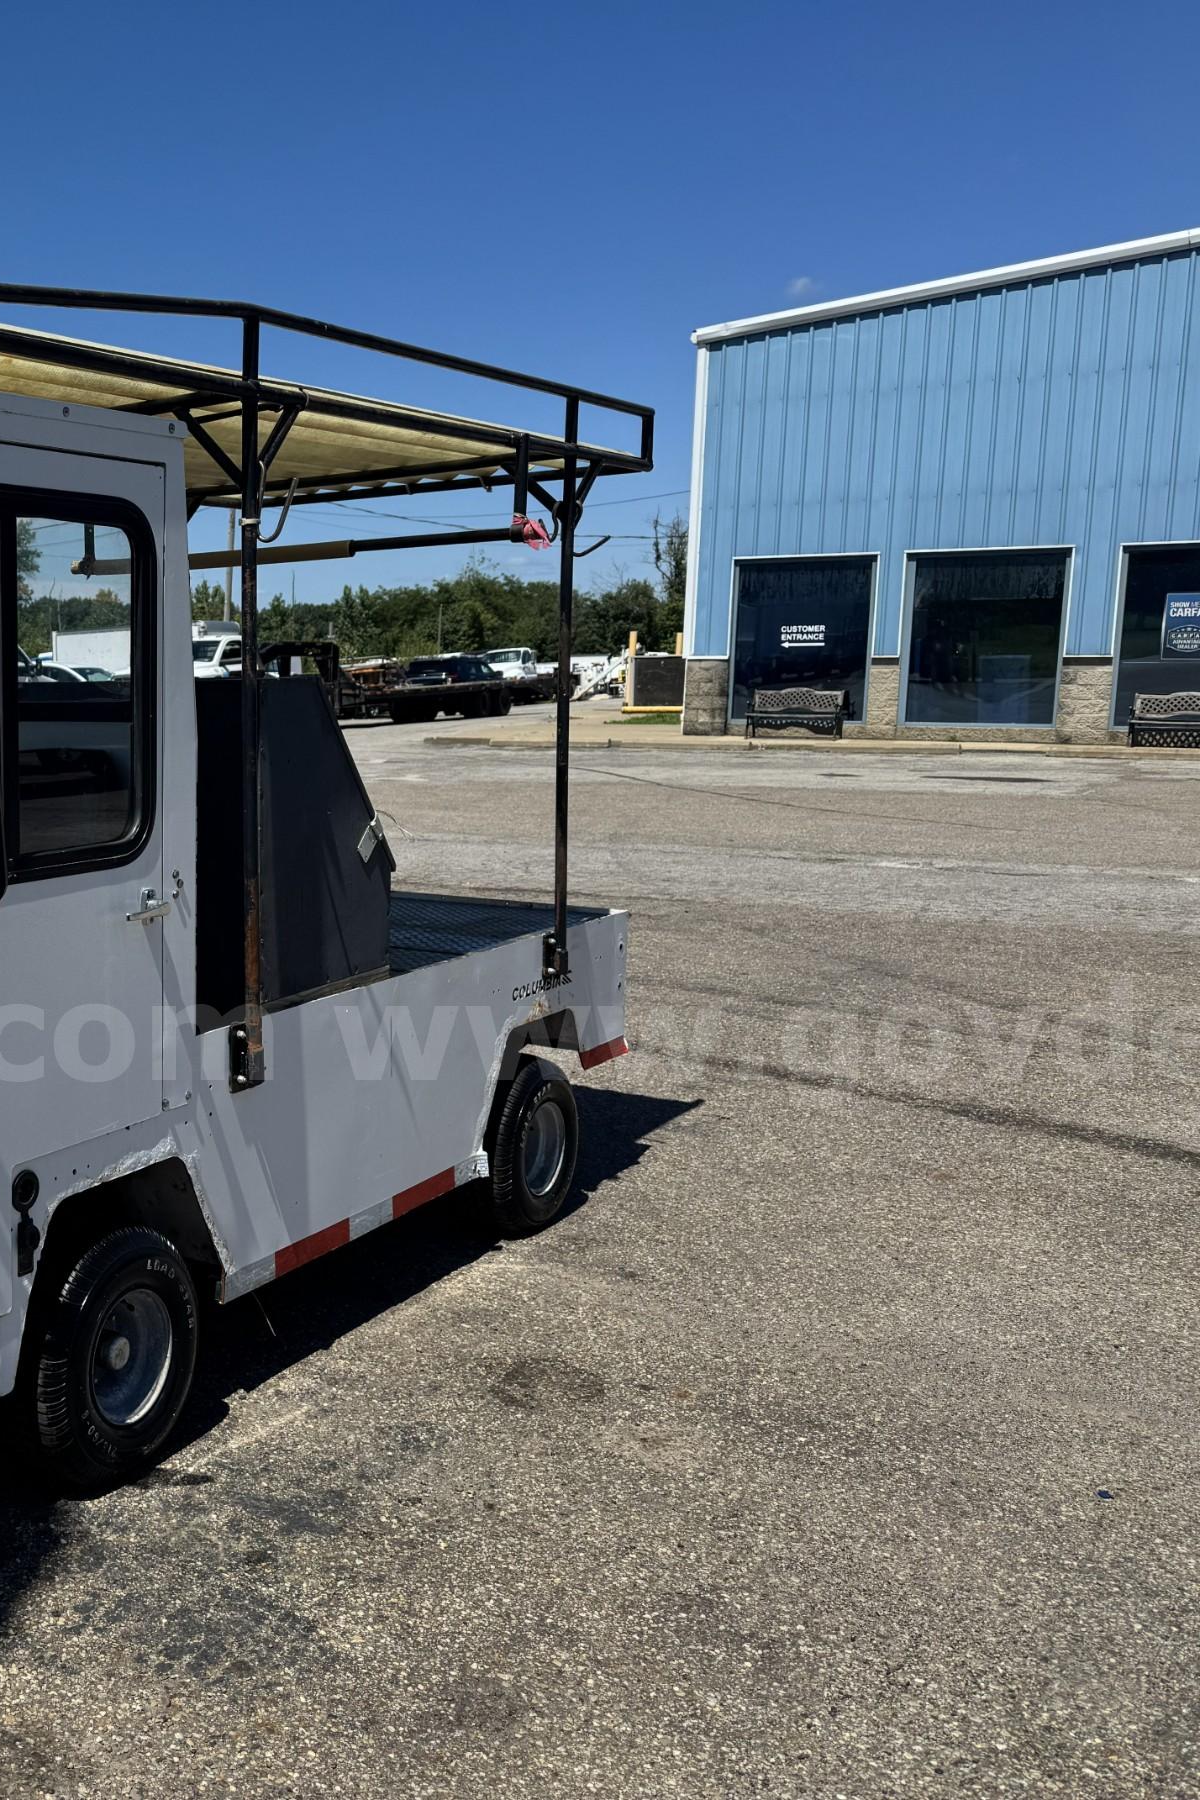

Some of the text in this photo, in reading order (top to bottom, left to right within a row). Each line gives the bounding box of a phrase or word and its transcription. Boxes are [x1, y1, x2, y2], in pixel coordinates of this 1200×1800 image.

[781, 625, 826, 633] CUSTOMER
[781, 633, 824, 641] ENTRANCE
[512, 975, 561, 1002] COLUMBIA
[146, 1258, 176, 1279] LOAD
